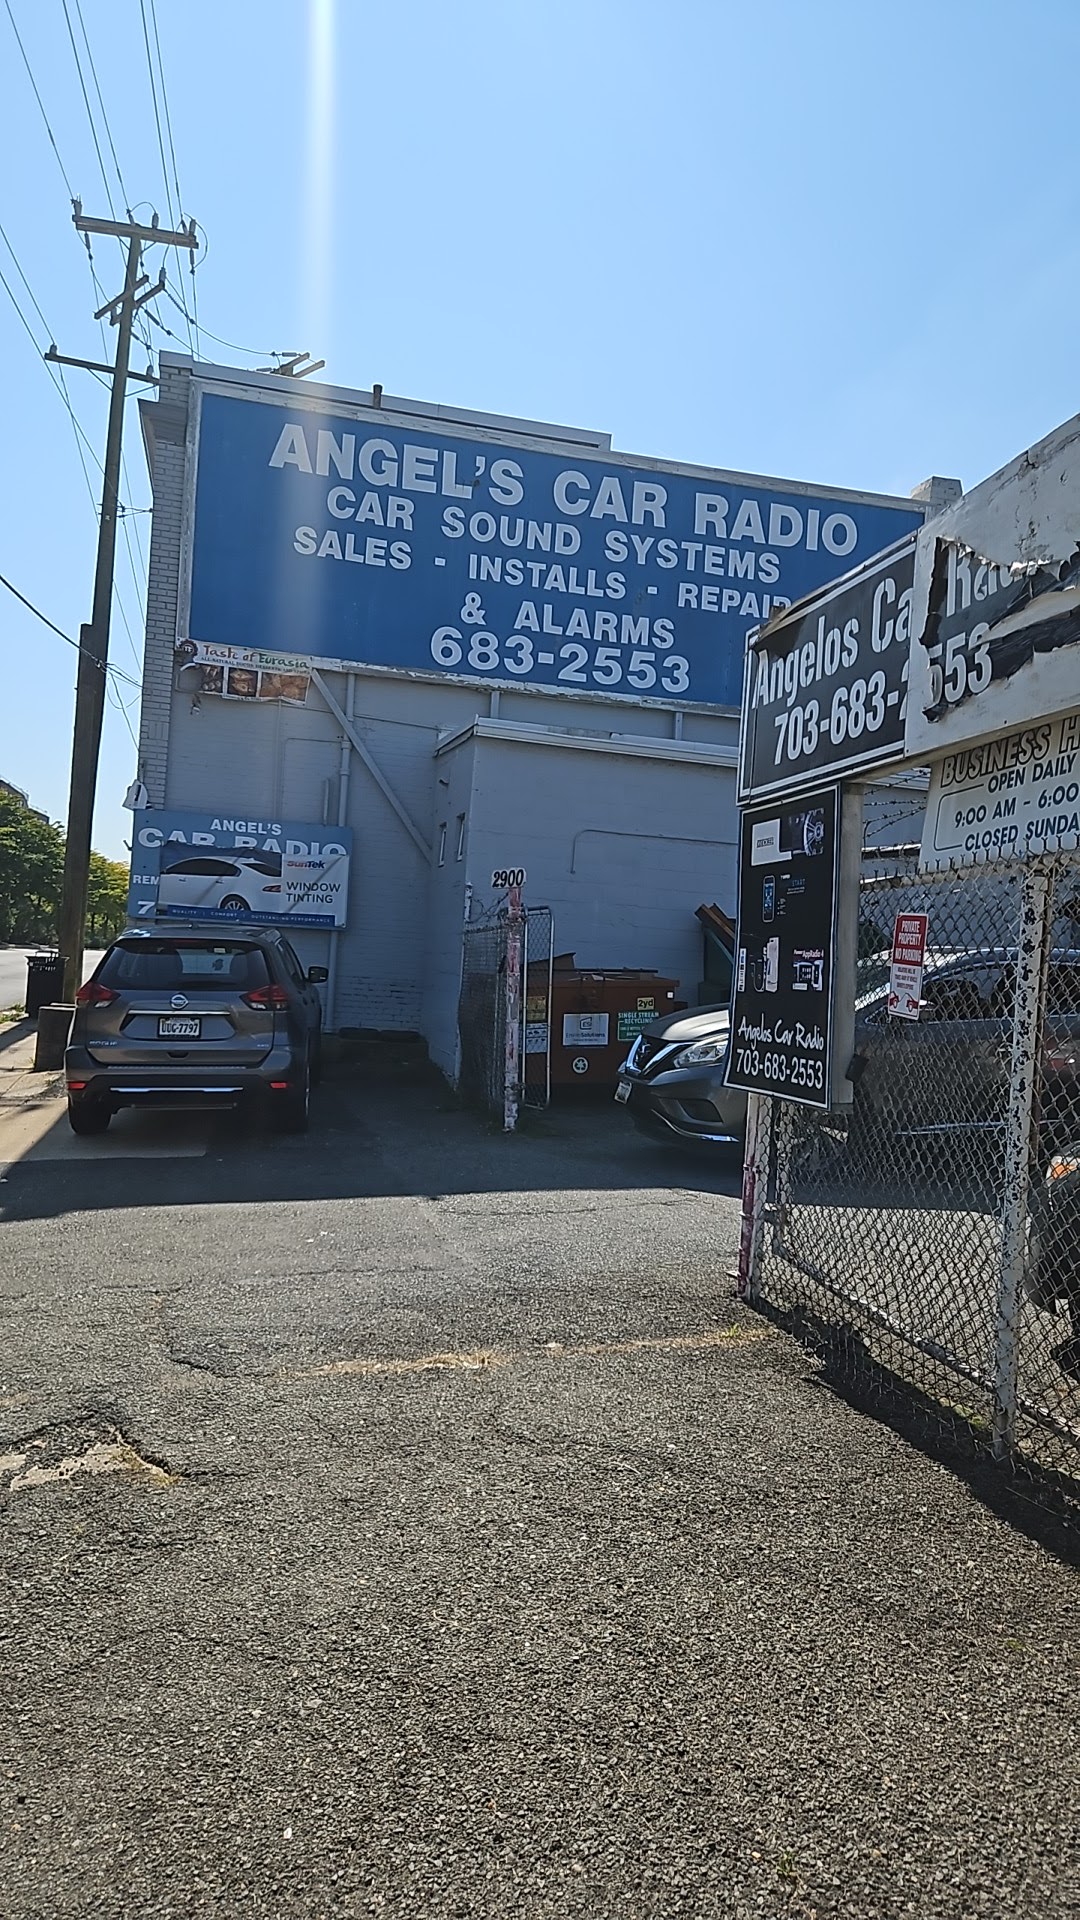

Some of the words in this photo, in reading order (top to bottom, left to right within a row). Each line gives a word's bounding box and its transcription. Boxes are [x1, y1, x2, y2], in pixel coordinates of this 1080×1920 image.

[268, 423, 525, 506] ANGEL'S
[553, 470, 668, 528] CAR
[694, 492, 858, 556] RADIO
[327, 486, 415, 531] CAR
[441, 506, 581, 555] SOUND
[604, 530, 781, 583] SYSTEMS
[293, 526, 413, 570] SALES
[469, 554, 627, 599] INSTALLS
[460, 592, 487, 626] &
[514, 601, 675, 649] ALARMS
[203, 645, 239, 660] Taste
[243, 651, 259, 661] of
[258, 652, 310, 669] Eurasia
[431, 626, 690, 693] 683-2553
[752, 615, 860, 710] Angelos
[872, 578, 914, 653] Ca
[940, 723, 1052, 788] BUSINESS
[988, 766, 1026, 793] OPEN
[1032, 753, 1077, 783] DAILY
[954, 804, 987, 829] 9:00
[992, 797, 1017, 820] AM
[1038, 782, 1079, 809] 6:00
[210, 818, 282, 836] ANGEL'S
[965, 824, 1019, 851] CLOSED
[1025, 811, 1080, 841] SUNDA
[287, 860, 326, 869] SunTek
[492, 868, 525, 888] 2900
[286, 881, 341, 893] WINDOW
[286, 892, 334, 904] TINTING
[898, 932, 922, 946] PROPERTY
[901, 920, 921, 933] PRIVATE
[895, 947, 903, 960] NO
[902, 947, 922, 962] PARKING
[638, 999, 654, 1009] 2yd
[638, 1011, 660, 1019] STREAM
[737, 1012, 773, 1051] Angelos
[774, 1018, 795, 1047] Car
[795, 1021, 824, 1051] Radio
[736, 1048, 824, 1090] 703-683-2553
